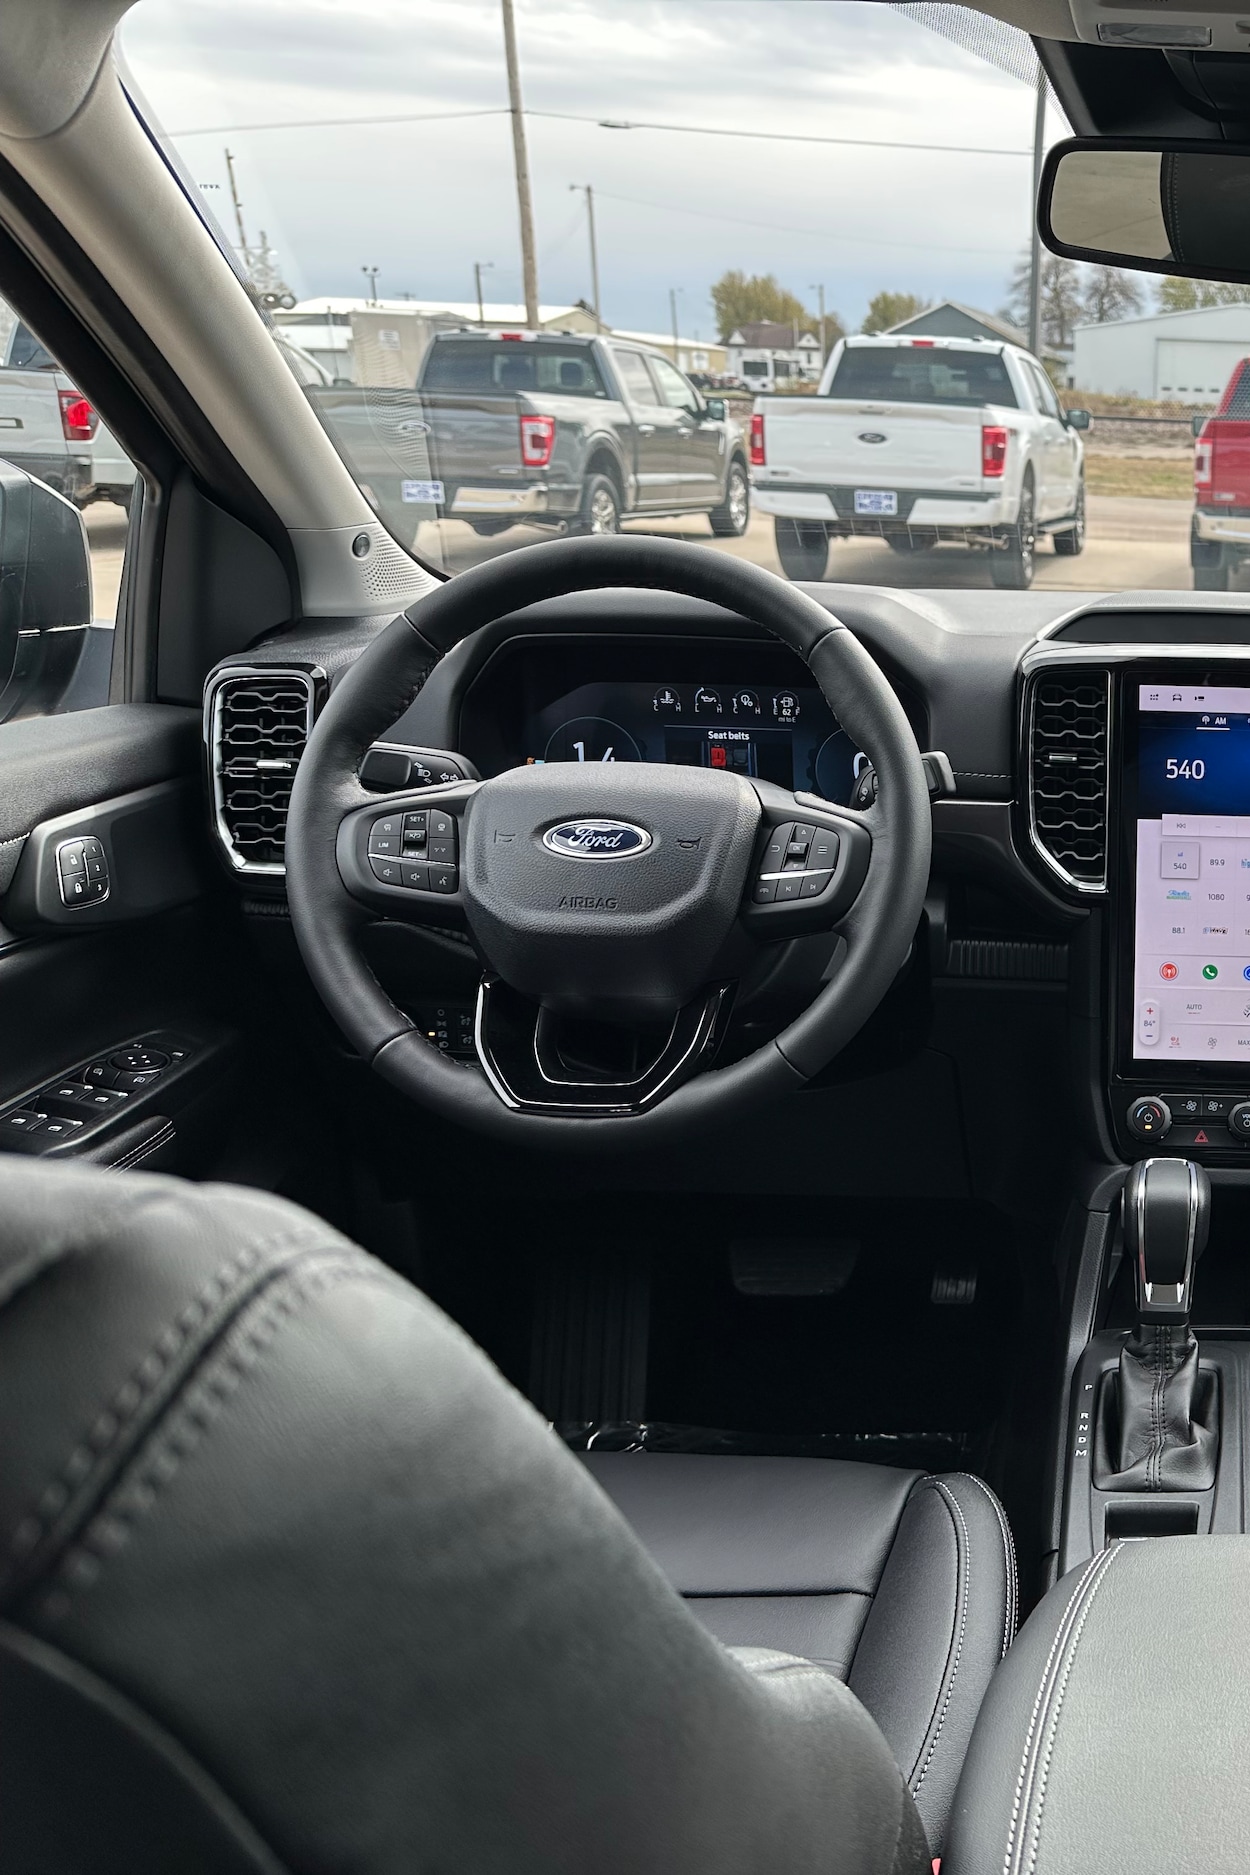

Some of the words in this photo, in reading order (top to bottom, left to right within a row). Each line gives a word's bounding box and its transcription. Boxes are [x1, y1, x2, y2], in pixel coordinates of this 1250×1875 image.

[1214, 717, 1227, 725] AM
[708, 731, 727, 740] Seat
[728, 731, 750, 740] belts
[1166, 759, 1205, 780] 540
[568, 826, 624, 848] Ford
[1208, 893, 1225, 901] 1080
[558, 896, 619, 909] AIRBAG
[1075, 1449, 1087, 1457] M
